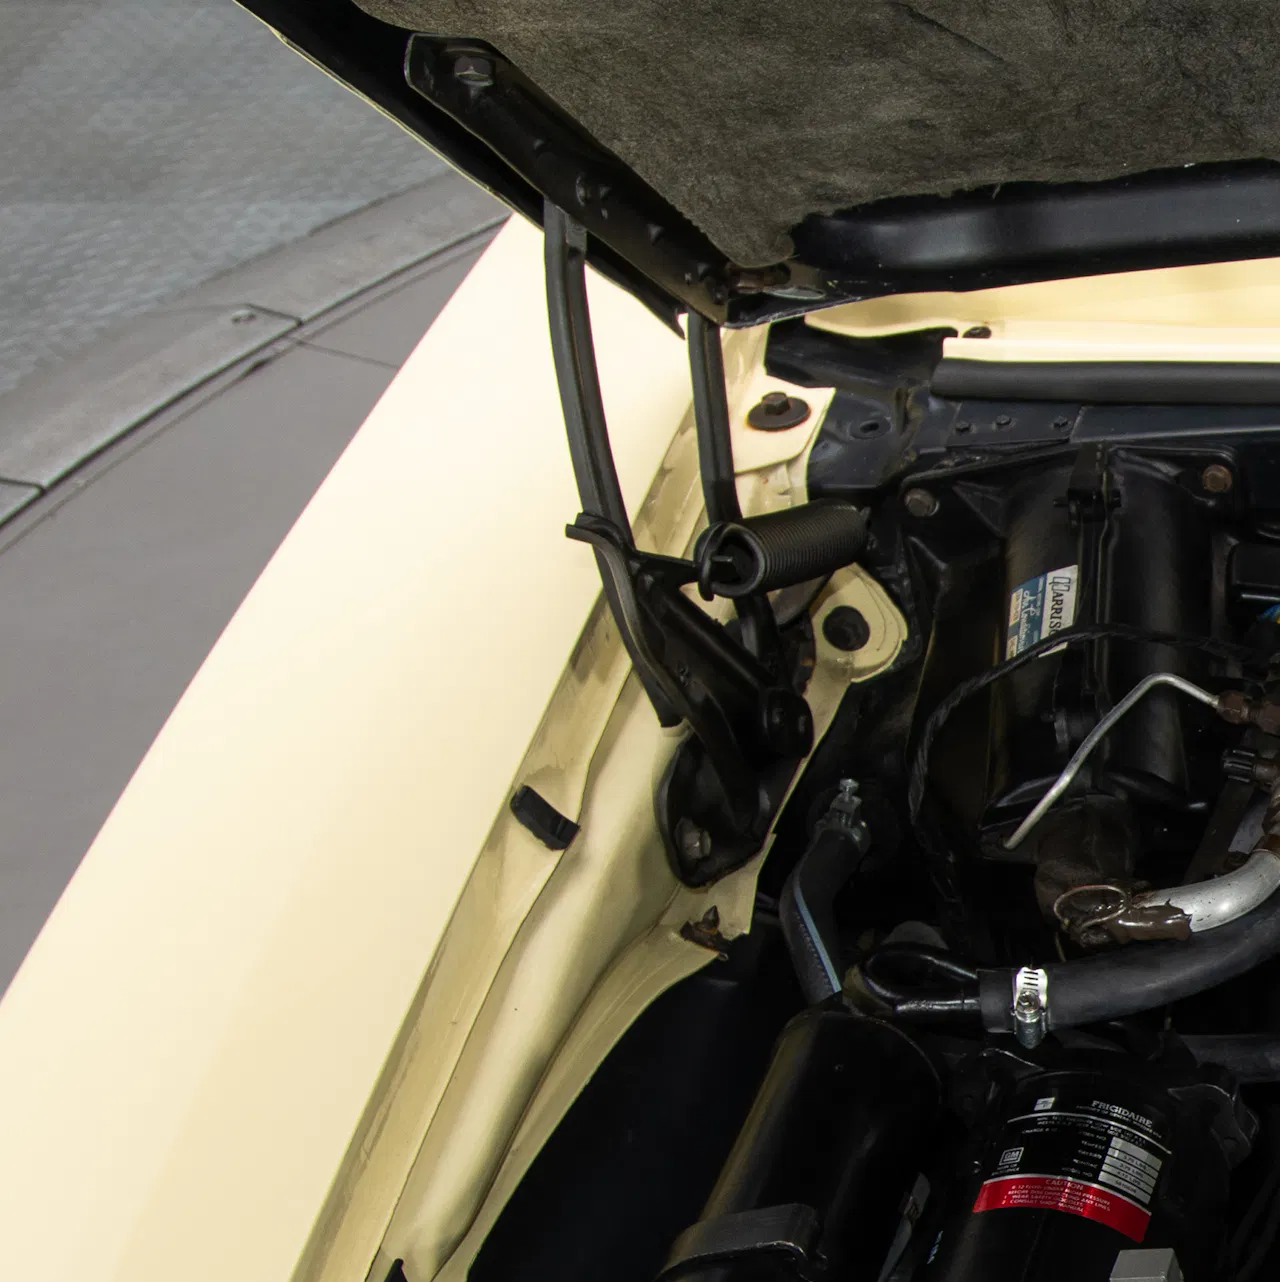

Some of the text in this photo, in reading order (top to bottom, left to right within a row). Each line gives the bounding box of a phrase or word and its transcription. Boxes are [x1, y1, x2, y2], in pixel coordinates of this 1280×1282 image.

[1049, 577, 1072, 636] HARRIS
[1091, 1100, 1153, 1128] FRIGIDAIRE
[1005, 1151, 1019, 1159] GM
[1046, 1180, 1083, 1190] CAUTION
[1082, 1193, 1110, 1205] PRESSURE
